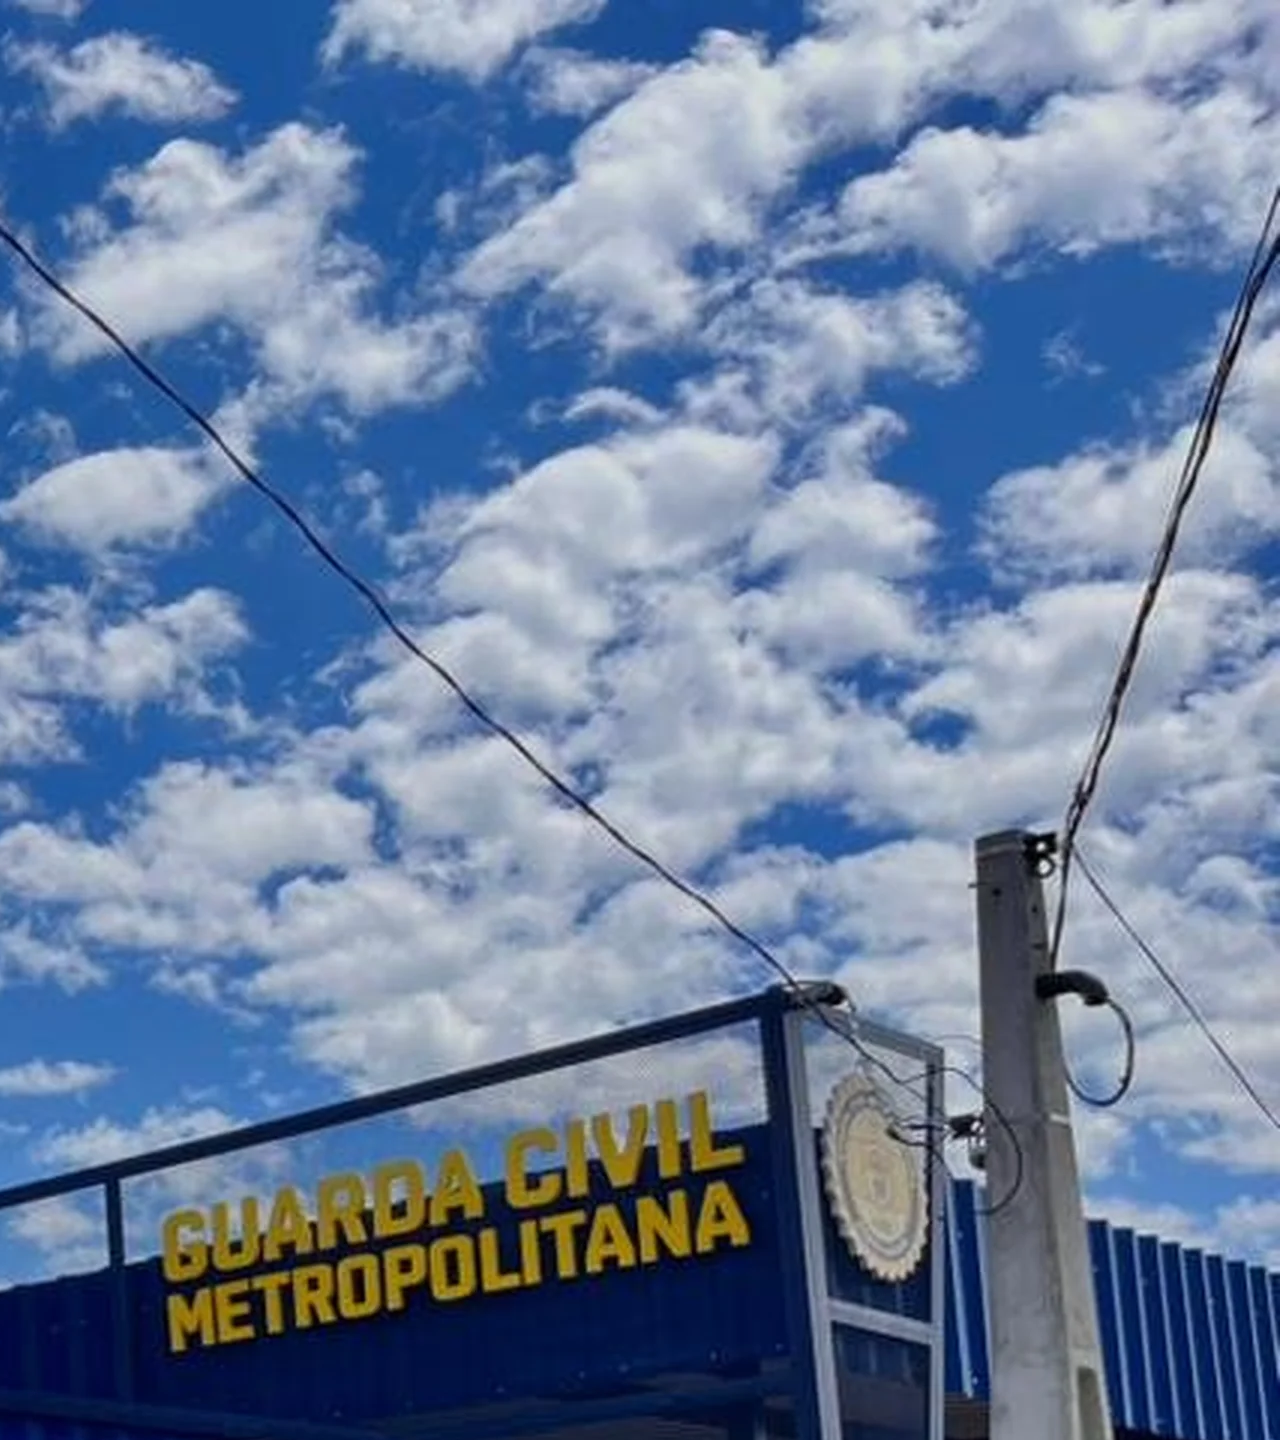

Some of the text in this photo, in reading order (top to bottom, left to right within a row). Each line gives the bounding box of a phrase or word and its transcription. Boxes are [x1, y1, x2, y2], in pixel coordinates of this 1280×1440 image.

[161, 1091, 745, 1284] GUARDA CIVIL
[169, 1180, 751, 1353] METROPOLITANA
